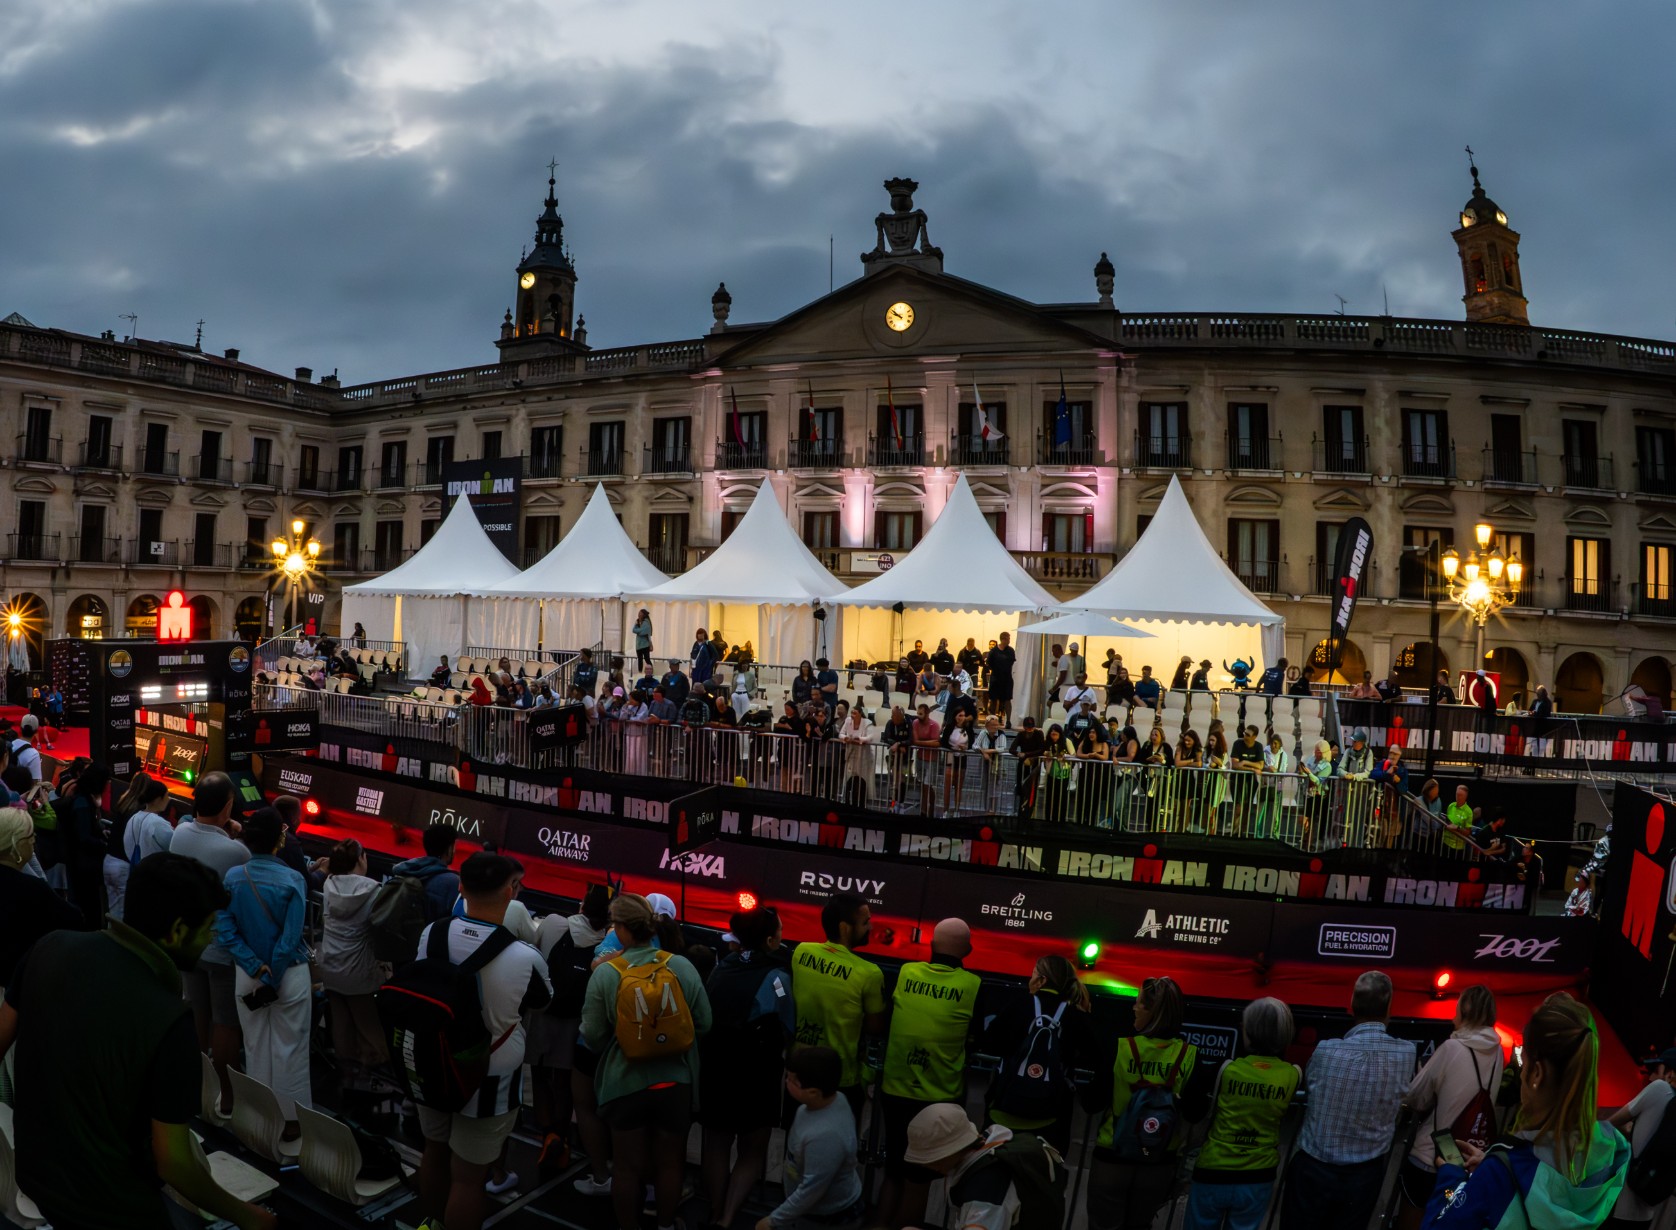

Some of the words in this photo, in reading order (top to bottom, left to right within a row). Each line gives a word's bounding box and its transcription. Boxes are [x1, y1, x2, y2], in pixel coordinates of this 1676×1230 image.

[447, 471, 515, 496] IRONMAN
[483, 523, 512, 532] POSSIBLE
[1336, 528, 1370, 630] IRONMAN
[308, 593, 324, 604] VIP
[110, 695, 130, 703] HOKA
[287, 723, 311, 733] HOKA
[536, 723, 556, 735] QATAR
[1451, 724, 1555, 758] IRONMAN
[1563, 729, 1659, 763] IRONMAN
[280, 769, 313, 786] EUSKADI
[346, 743, 423, 778] IRONMAN
[429, 761, 505, 798] IRONMAN
[508, 776, 613, 815] IRONMAN
[751, 811, 886, 854] IRONMAN
[899, 825, 1043, 873] IRONMAN
[1057, 843, 1209, 887] IRONMAN
[1222, 858, 1372, 902] IRONMAN
[1383, 867, 1526, 909] IRONMAN
[537, 827, 591, 851] QATAR
[547, 845, 590, 862] AIRWAYS
[800, 871, 886, 895] ROUVY
[981, 904, 1053, 921] BREITLING
[1004, 918, 1026, 928] 1884
[1165, 914, 1230, 934] ATHLETIC
[1173, 933, 1207, 944] BREWING
[1325, 930, 1390, 944] PRECISION
[1324, 941, 1342, 950] FUEL
[1349, 943, 1389, 952] HYDRATION
